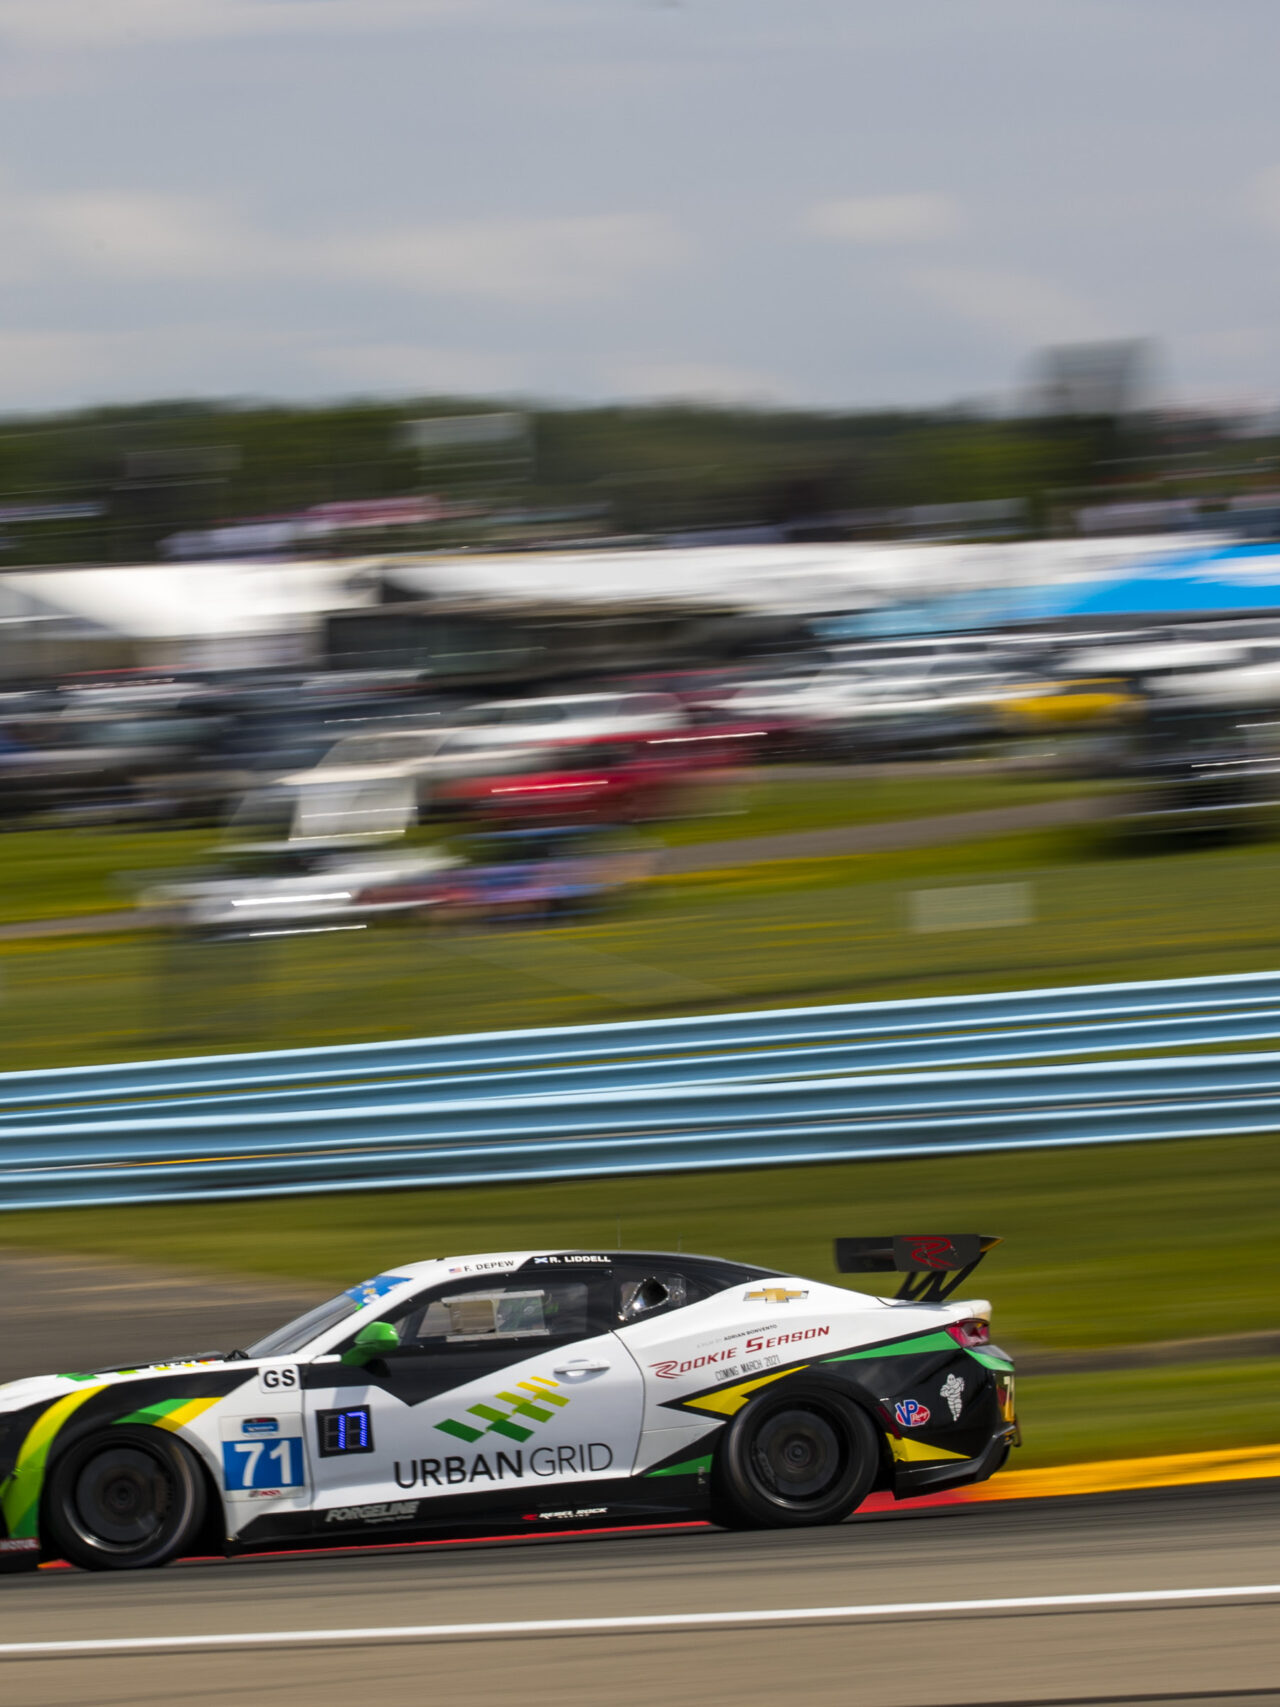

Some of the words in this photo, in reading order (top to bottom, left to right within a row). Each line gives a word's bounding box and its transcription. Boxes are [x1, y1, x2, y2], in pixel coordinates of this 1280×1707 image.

[476, 1260, 515, 1270] DEPEW
[564, 1255, 612, 1263] LIDDELL
[724, 1332, 746, 1341] ADRIAN
[714, 1366, 740, 1381] COMING
[741, 1359, 762, 1373] MARCH
[764, 1354, 781, 1367] 2021
[263, 1369, 296, 1388] GS
[895, 1400, 918, 1426] VP
[234, 1440, 292, 1487] 71
[393, 1449, 524, 1489] URBAN
[529, 1442, 614, 1477] GRID
[324, 1500, 421, 1522] FORGELINE
[576, 1507, 608, 1515] ROCK
